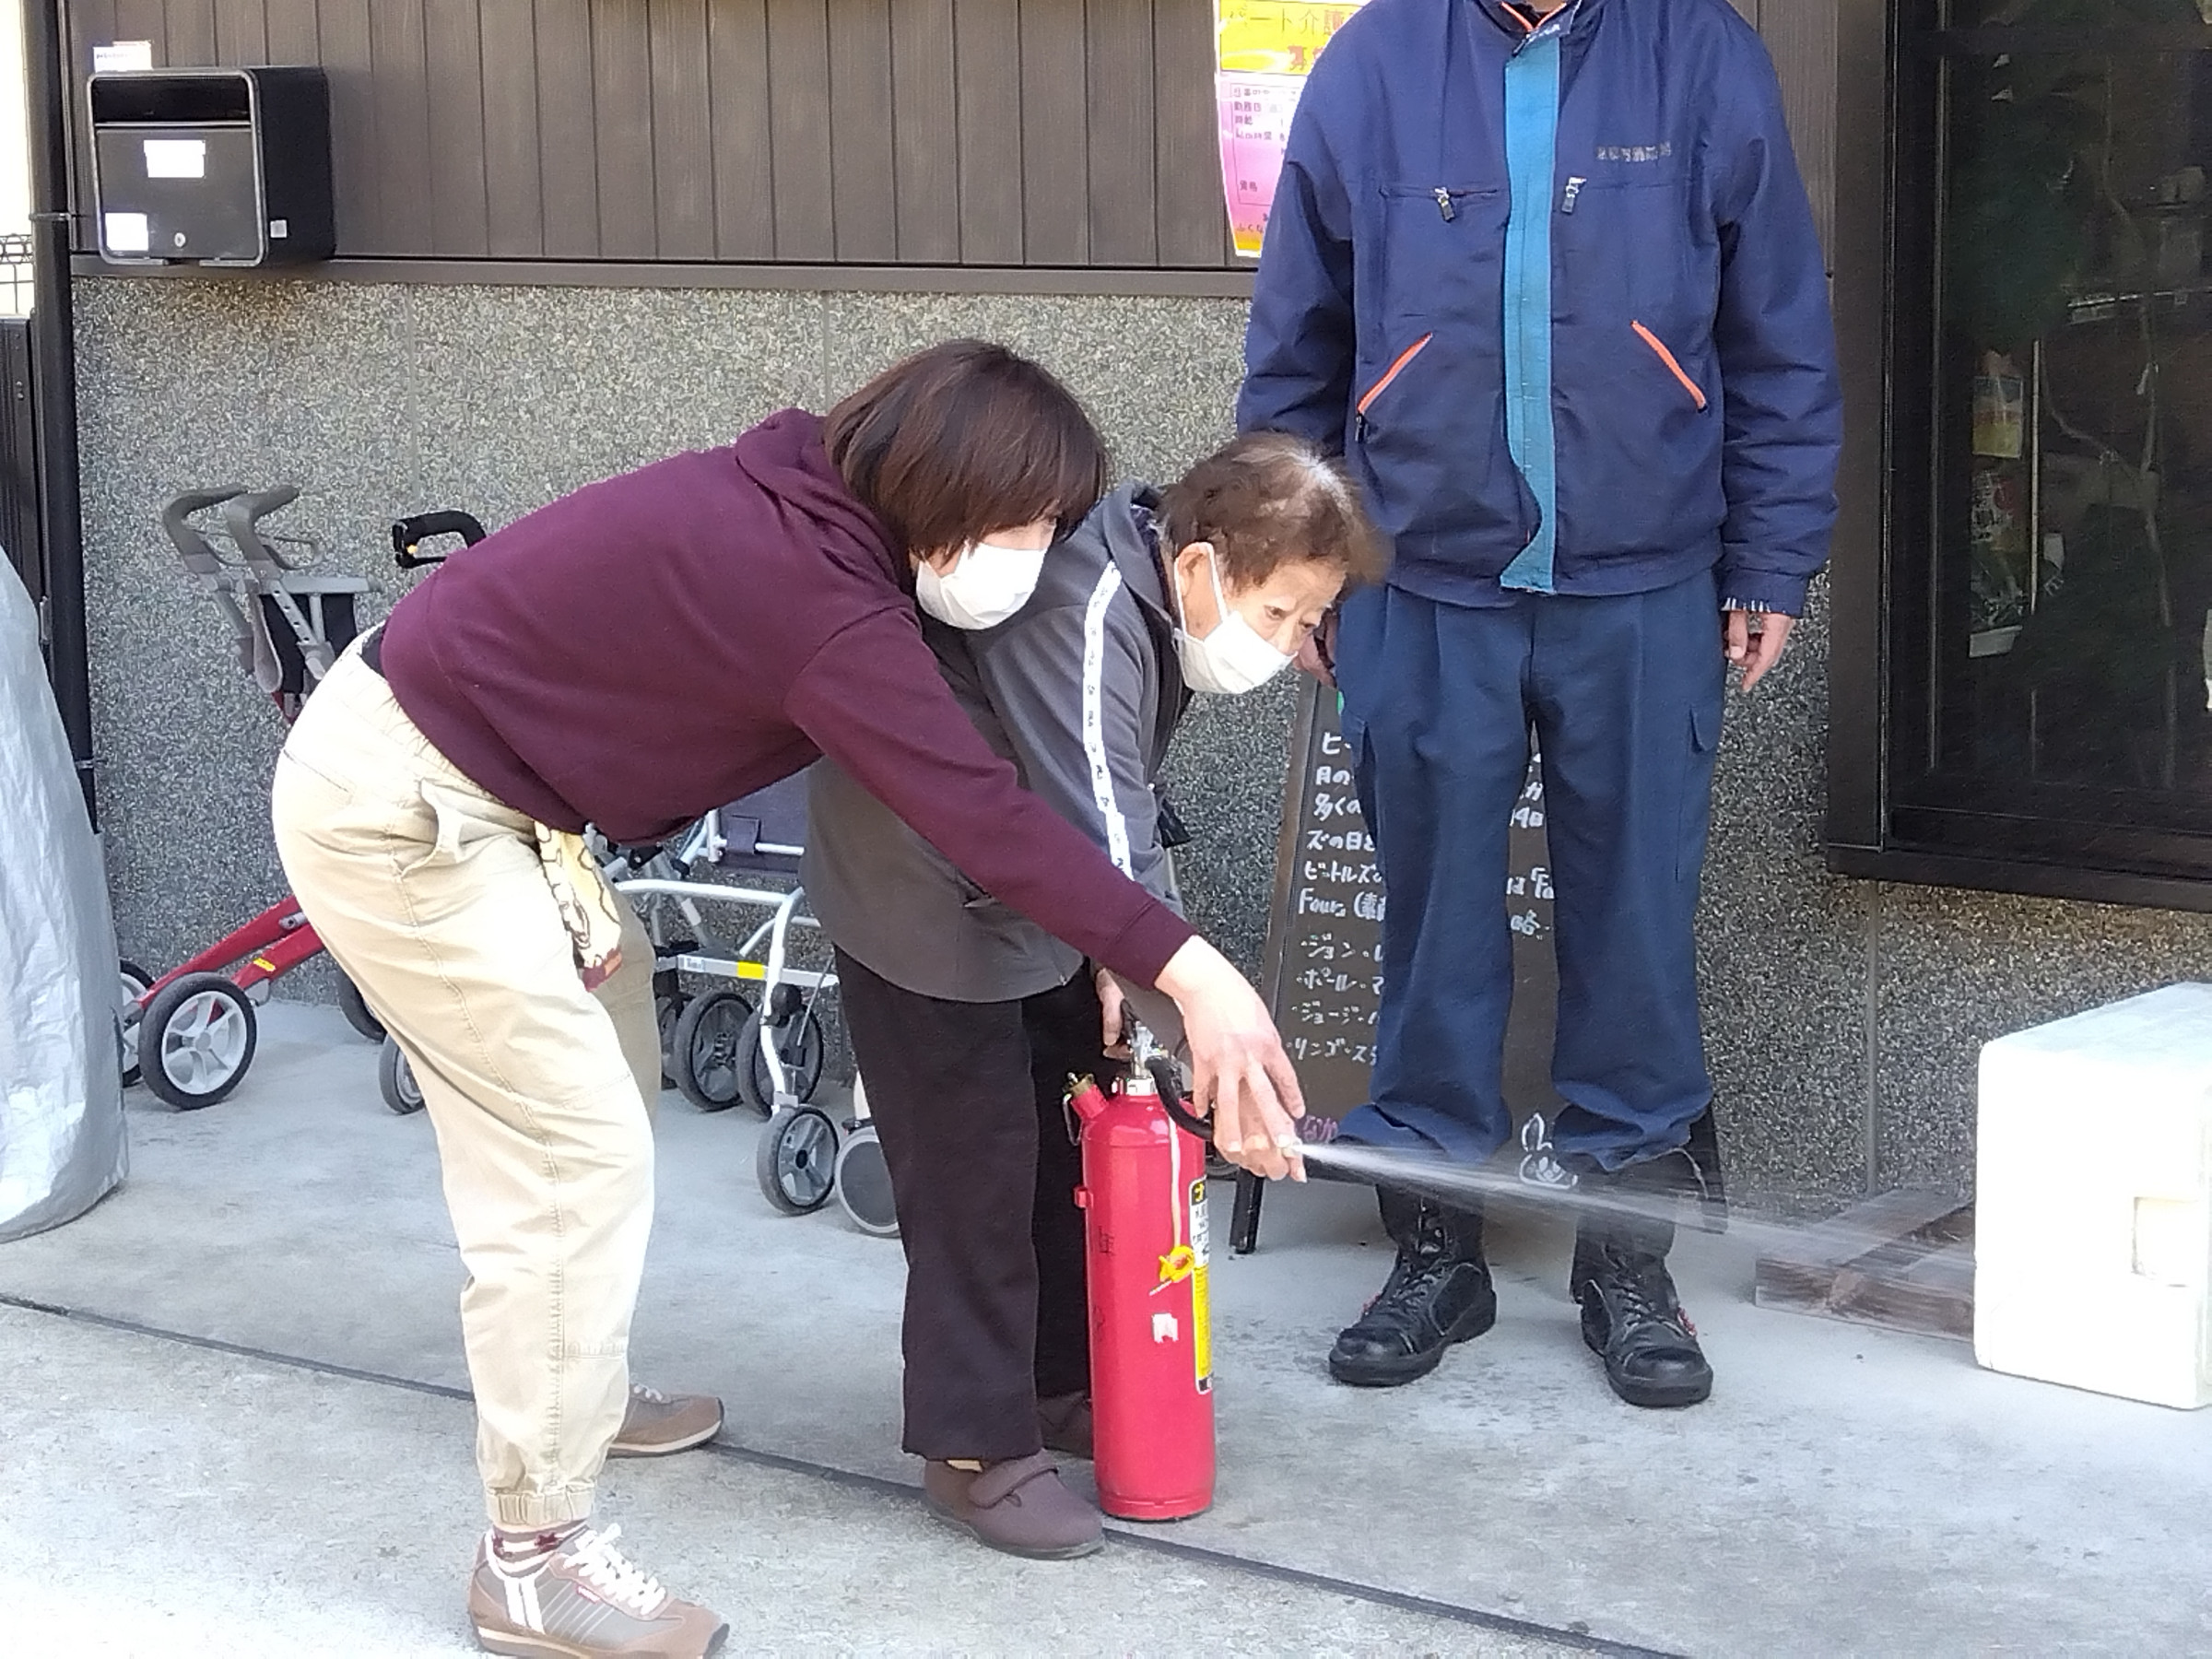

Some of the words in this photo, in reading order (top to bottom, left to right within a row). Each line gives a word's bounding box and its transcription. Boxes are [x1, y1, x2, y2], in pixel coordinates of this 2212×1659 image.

[1227, 3, 1352, 36] パート介護
